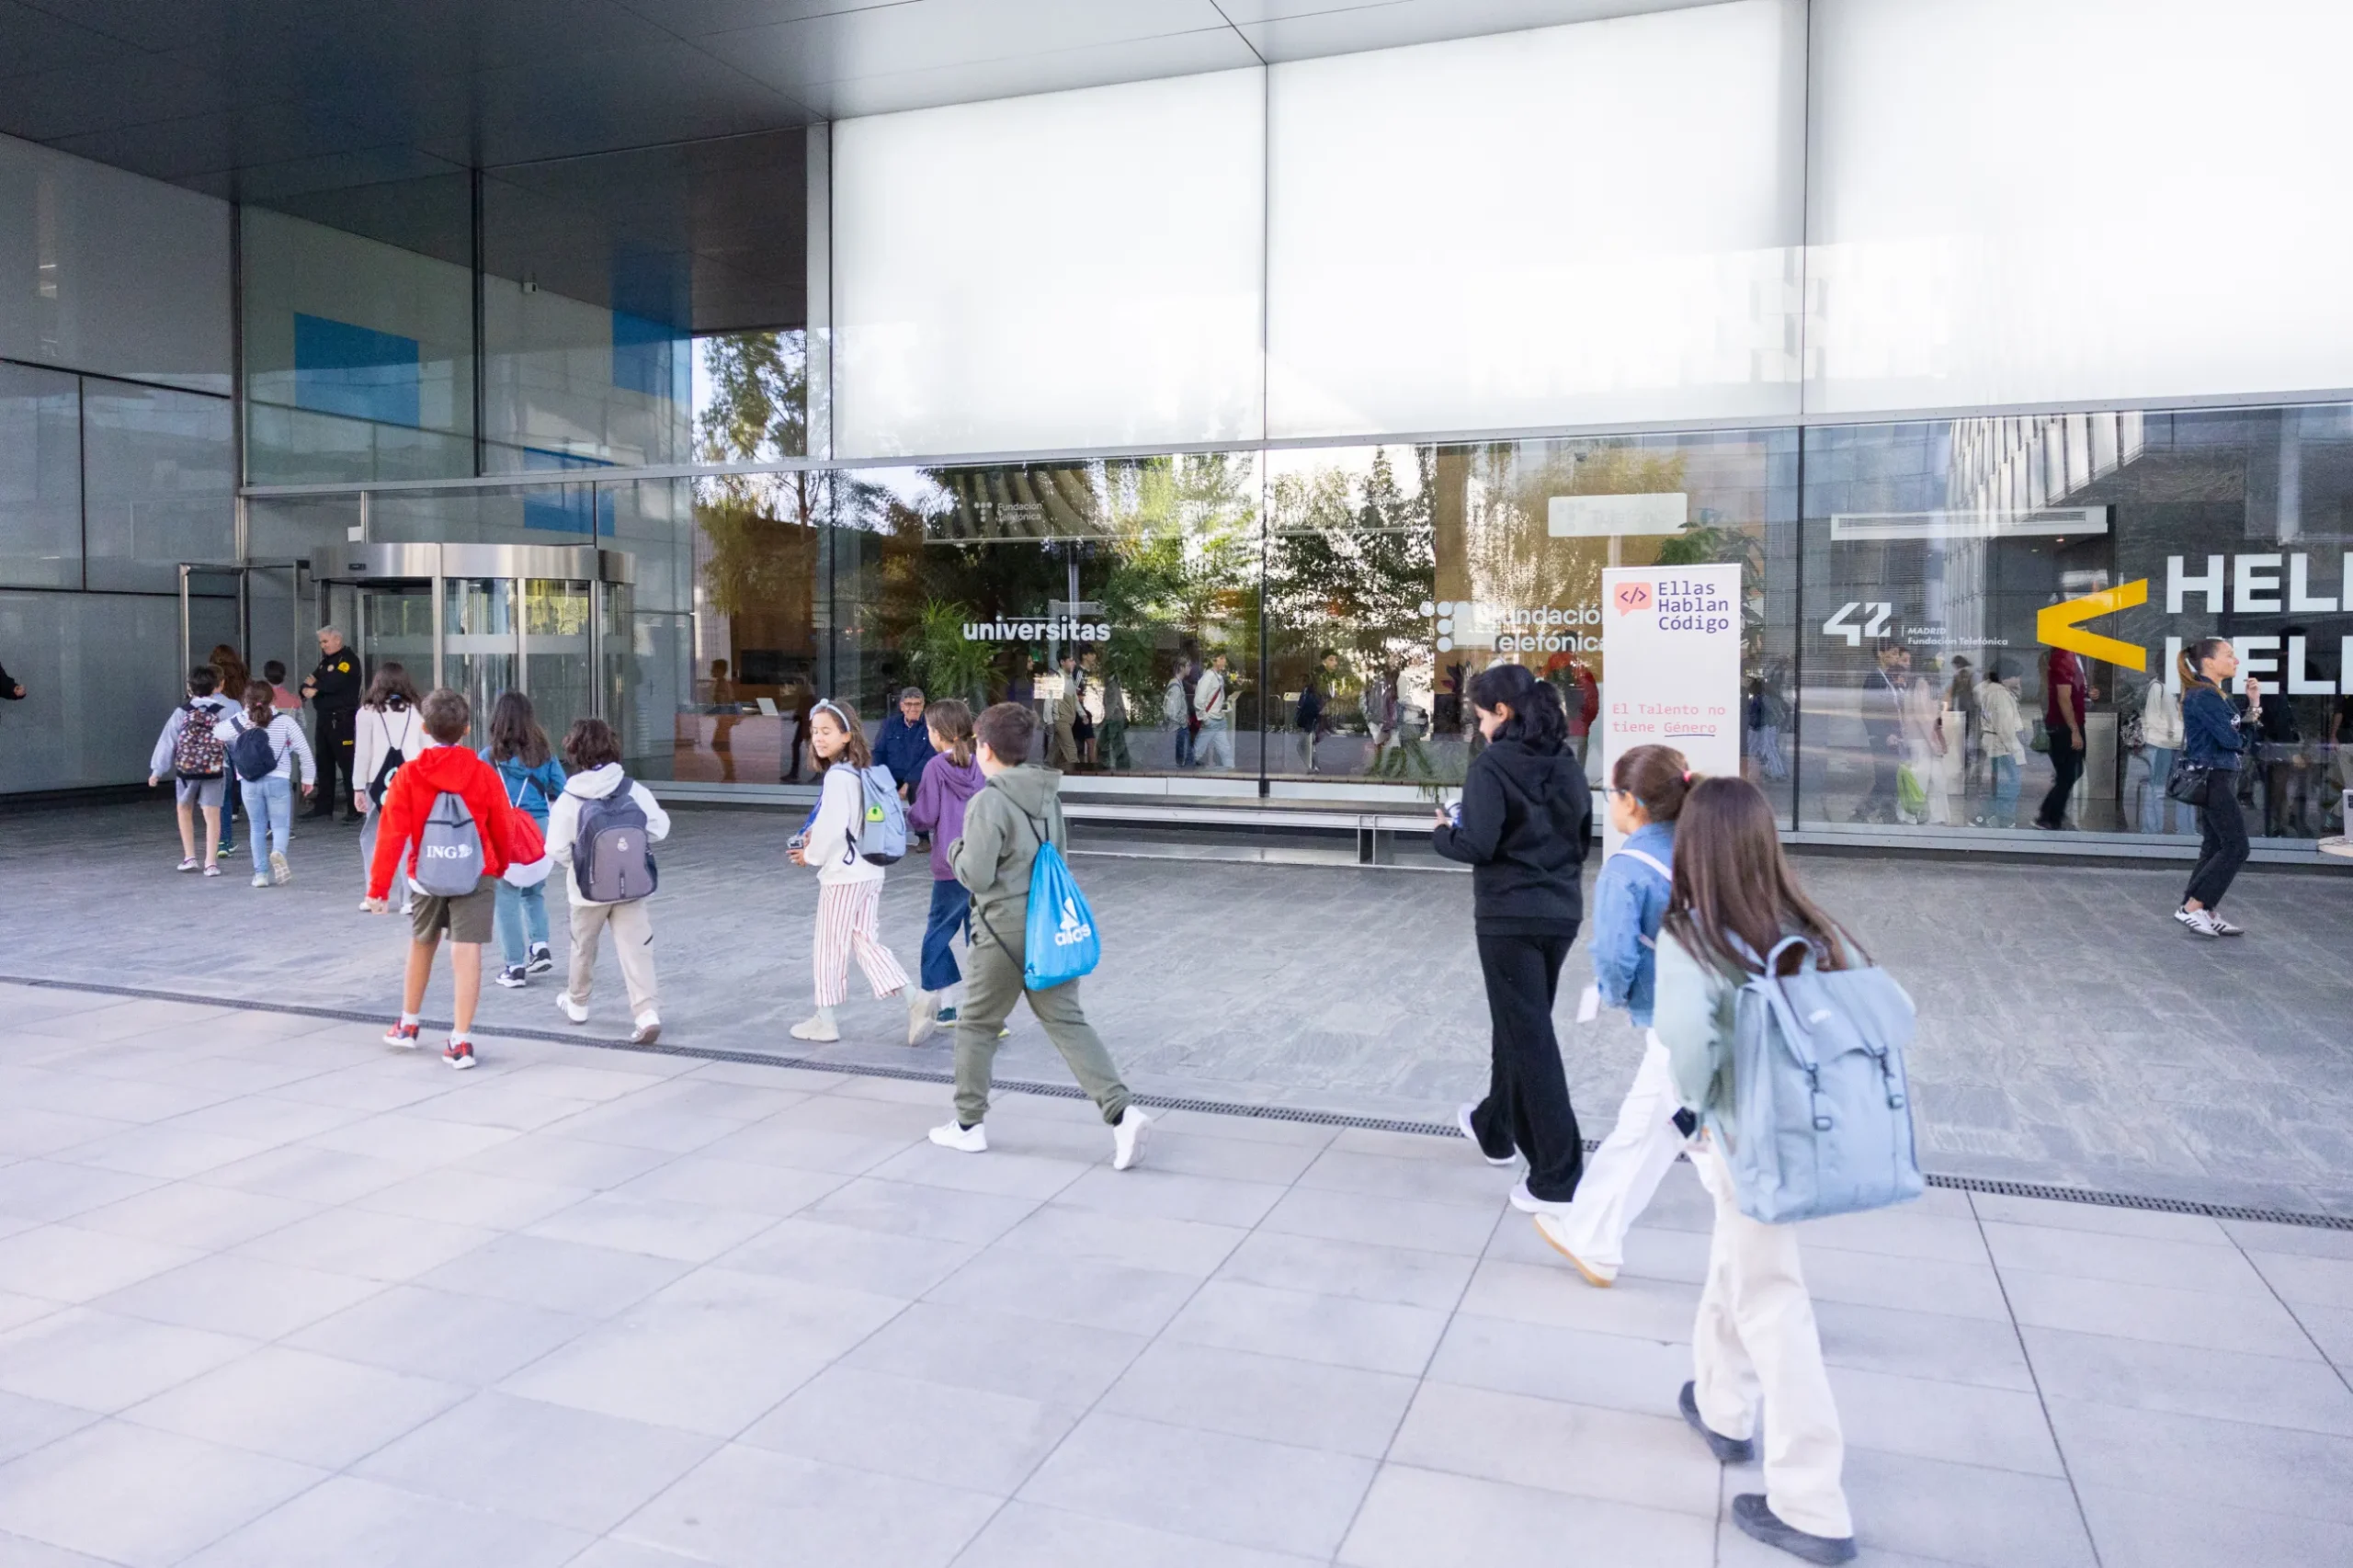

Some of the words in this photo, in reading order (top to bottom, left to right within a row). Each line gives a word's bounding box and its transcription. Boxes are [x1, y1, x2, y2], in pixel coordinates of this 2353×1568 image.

[1658, 580, 1715, 596] Ellas
[2165, 551, 2353, 614] HEL
[1658, 597, 1728, 613] Hablan
[963, 615, 1111, 642] universitas
[1658, 615, 1729, 633] Código
[1823, 602, 1892, 646] 42
[1907, 627, 1947, 635] MADRID
[1907, 635, 1957, 645] Fundación
[1959, 636, 2008, 645] Telefónica
[1612, 703, 1629, 714] El
[1638, 703, 1699, 715] Talento
[1708, 706, 1726, 715] no
[1612, 721, 1655, 733] tiene
[1664, 722, 1717, 733] Género
[426, 846, 457, 858] ING
